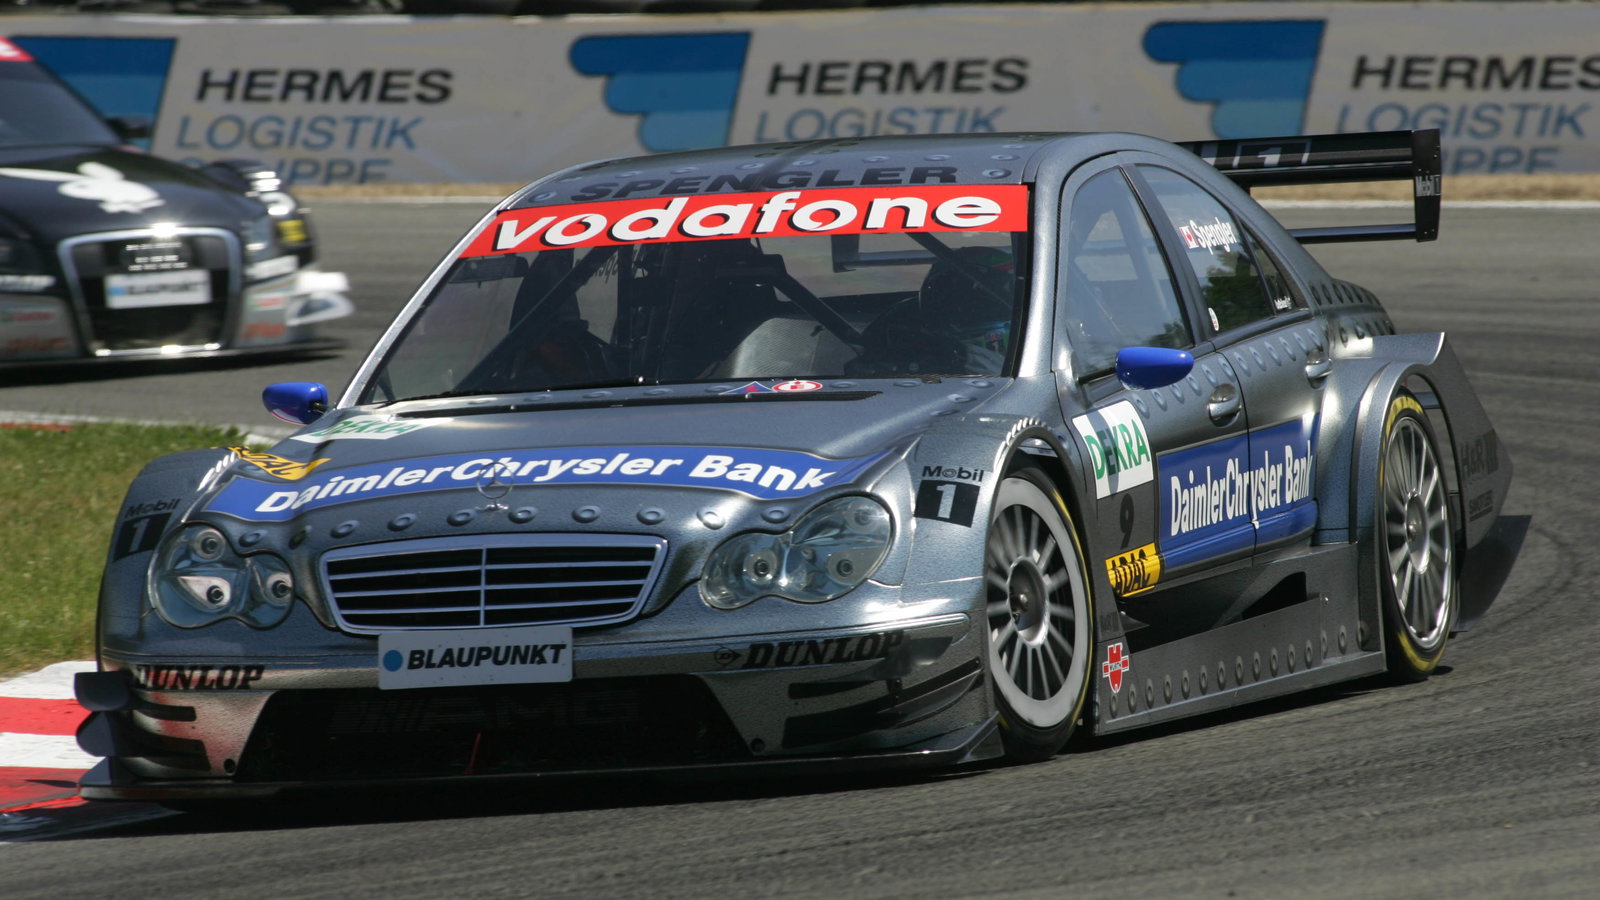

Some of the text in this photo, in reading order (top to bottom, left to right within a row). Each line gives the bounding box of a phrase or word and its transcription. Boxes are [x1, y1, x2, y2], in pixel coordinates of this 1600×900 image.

[196, 68, 453, 103] HERMES
[767, 58, 1029, 96] HERMES
[1352, 55, 1600, 91] HERMES
[176, 115, 425, 150] LOGISTIK
[754, 106, 1006, 142] LOGISTIK
[571, 165, 958, 201] SPENGLER
[492, 191, 1003, 252] vodafone
[1189, 216, 1238, 255] Spengler
[1084, 419, 1151, 480] DEKRA
[254, 453, 838, 513] DaimlerChrysler Bank
[922, 465, 985, 482] Mobil
[1170, 440, 1314, 536] DaimlerChrysler Bank
[124, 498, 180, 518] Mobil
[936, 483, 957, 519] 1
[128, 518, 150, 553] 1
[1119, 493, 1135, 549] 9
[407, 644, 567, 670] BLAUPUNKT
[742, 629, 904, 669] DUNLOP
[135, 663, 265, 690] DUNLOP
